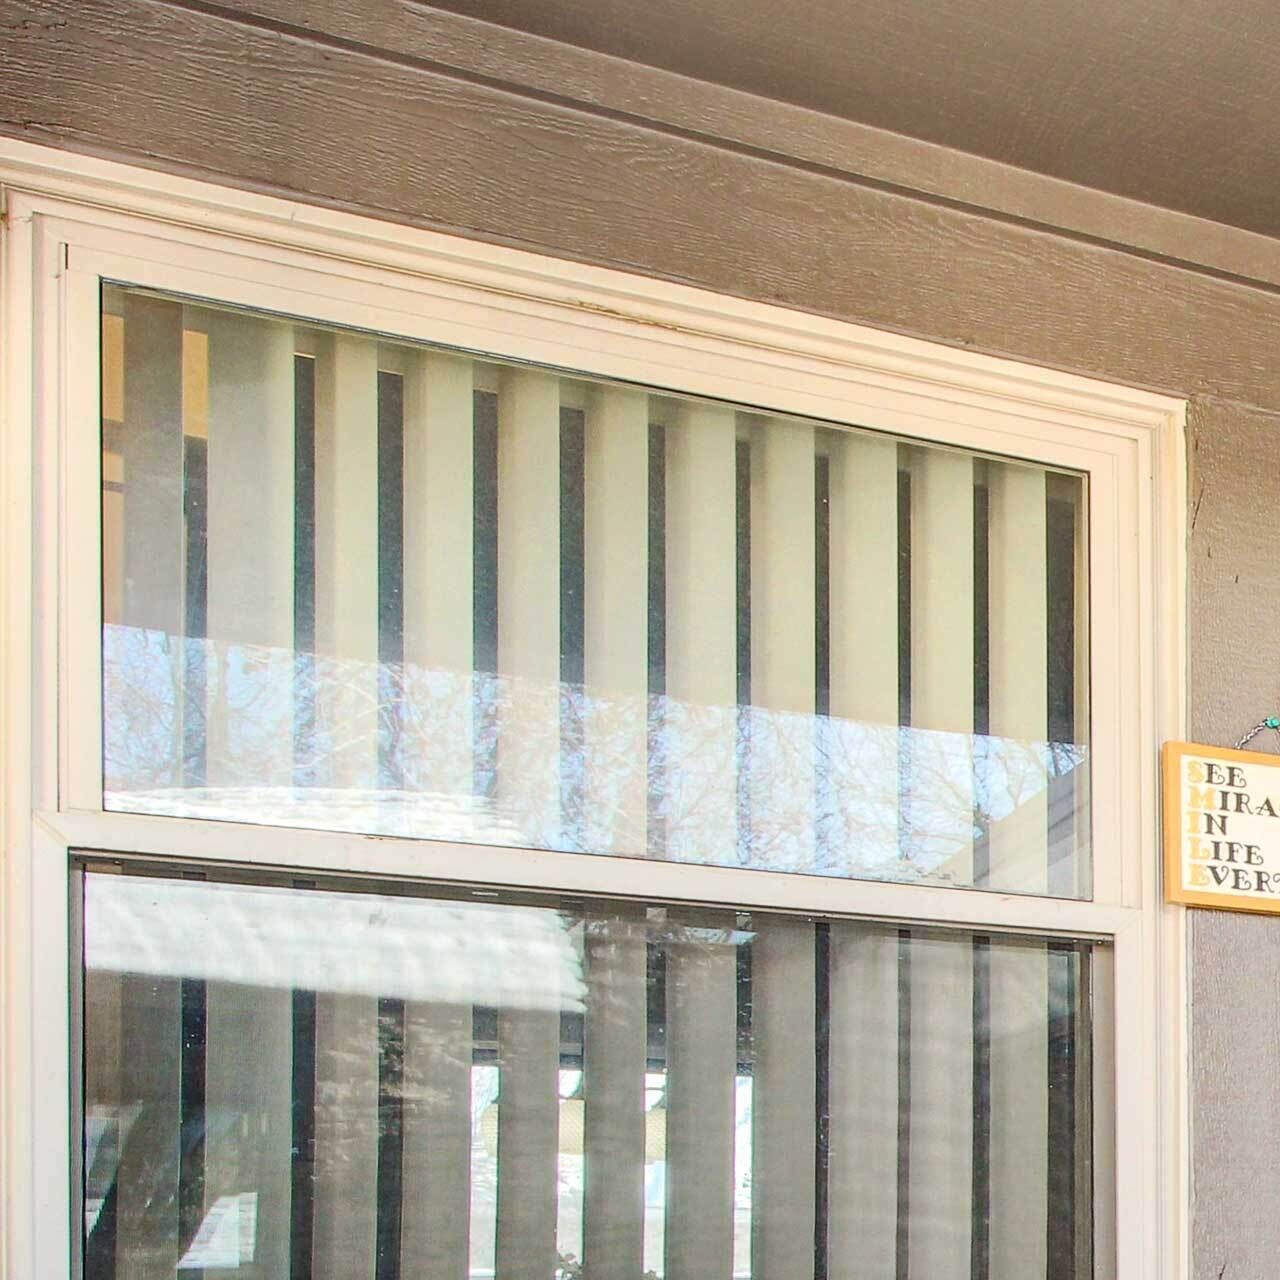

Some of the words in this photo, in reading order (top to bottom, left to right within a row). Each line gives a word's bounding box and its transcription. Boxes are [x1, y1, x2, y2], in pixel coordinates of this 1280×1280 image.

[1186, 761, 1247, 788] SEE
[1186, 811, 1228, 835] IN
[1188, 837, 1264, 865] LIFE
